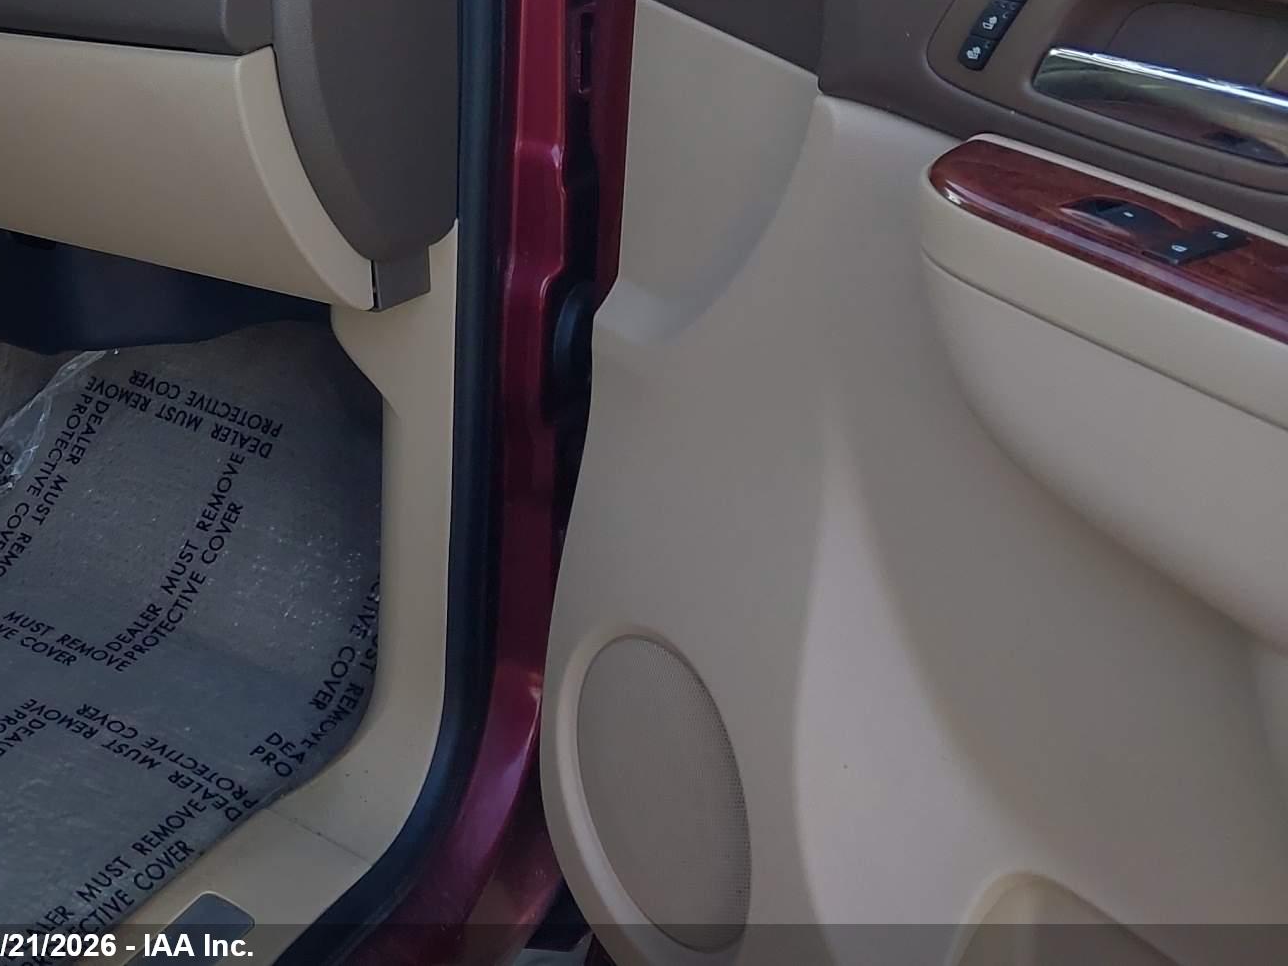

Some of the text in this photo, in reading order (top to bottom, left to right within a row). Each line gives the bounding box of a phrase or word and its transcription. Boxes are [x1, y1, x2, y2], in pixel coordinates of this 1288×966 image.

[65, 399, 110, 466] DEALER
[84, 376, 272, 459] DEALER MUST REMOVE
[128, 370, 283, 438] PROTECTIVE COVER
[26, 393, 93, 498] PROTECTIVE
[31, 474, 69, 526] MUST
[105, 452, 246, 652] DEALER MUST REMOVE
[125, 501, 244, 662] PROTECTIVE COVER
[2, 610, 55, 636] MUST
[55, 633, 131, 673] REMOVE
[20, 636, 77, 667] COVER
[308, 645, 356, 710] COVER
[300, 682, 364, 749] REMOVE
[20, 698, 243, 823] DEALER MUST REMOVE
[75, 703, 259, 809] PROTECTIVE COVER
[74, 856, 132, 904] MUST
[131, 798, 207, 856] REMOVE
[133, 840, 195, 892] COVER
